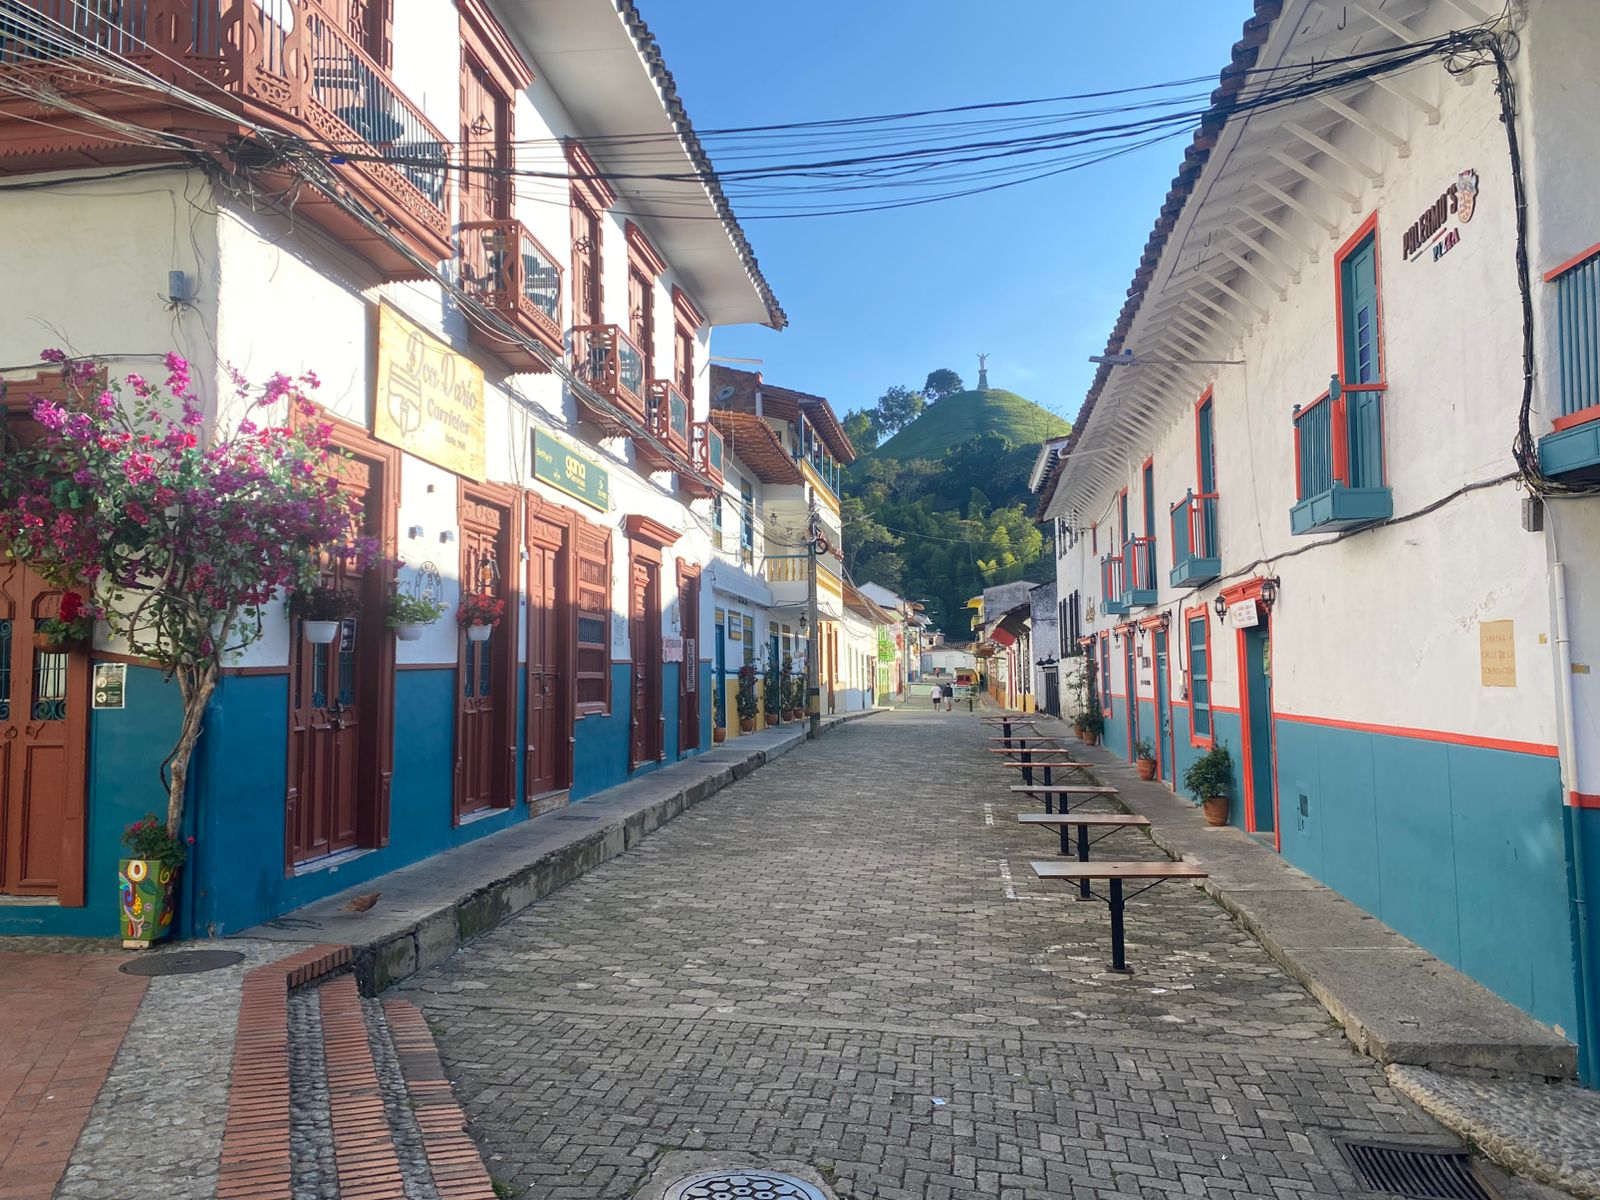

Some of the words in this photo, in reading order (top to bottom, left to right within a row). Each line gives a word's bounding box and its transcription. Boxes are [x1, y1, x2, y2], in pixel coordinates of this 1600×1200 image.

[1403, 183, 1458, 261] PALERMO'S
[406, 331, 440, 388] Don
[565, 455, 586, 480] gana
